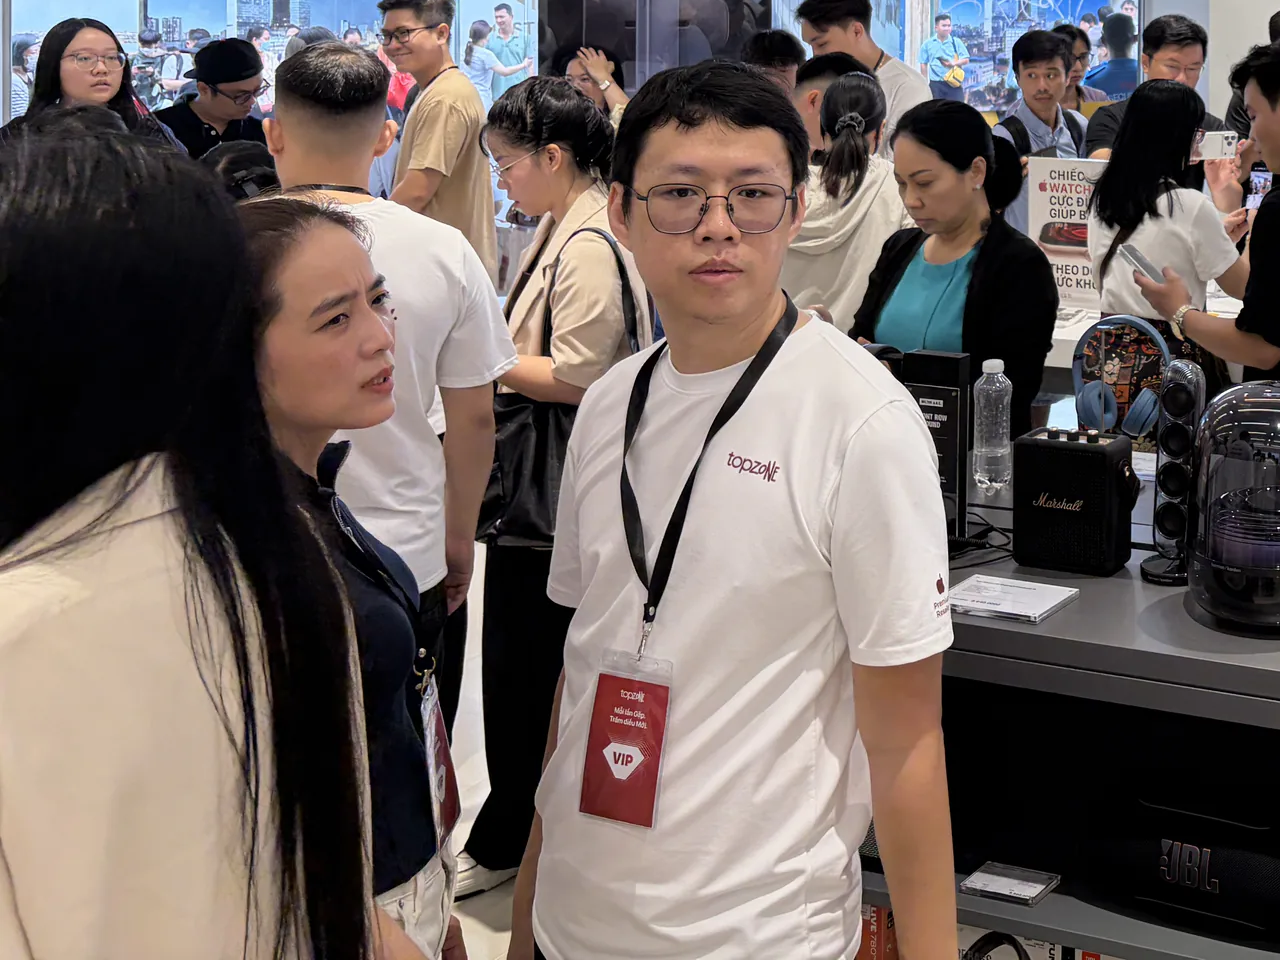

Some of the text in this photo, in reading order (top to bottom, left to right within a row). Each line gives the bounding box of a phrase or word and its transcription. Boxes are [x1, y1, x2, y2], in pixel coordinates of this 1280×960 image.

[1049, 167, 1086, 182] CHIẾC
[1049, 182, 1092, 195] WATCH
[1056, 272, 1073, 288] ỨC
[1032, 492, 1084, 511] Marshall
[612, 751, 633, 766] VIP
[1160, 839, 1220, 894] JBL
